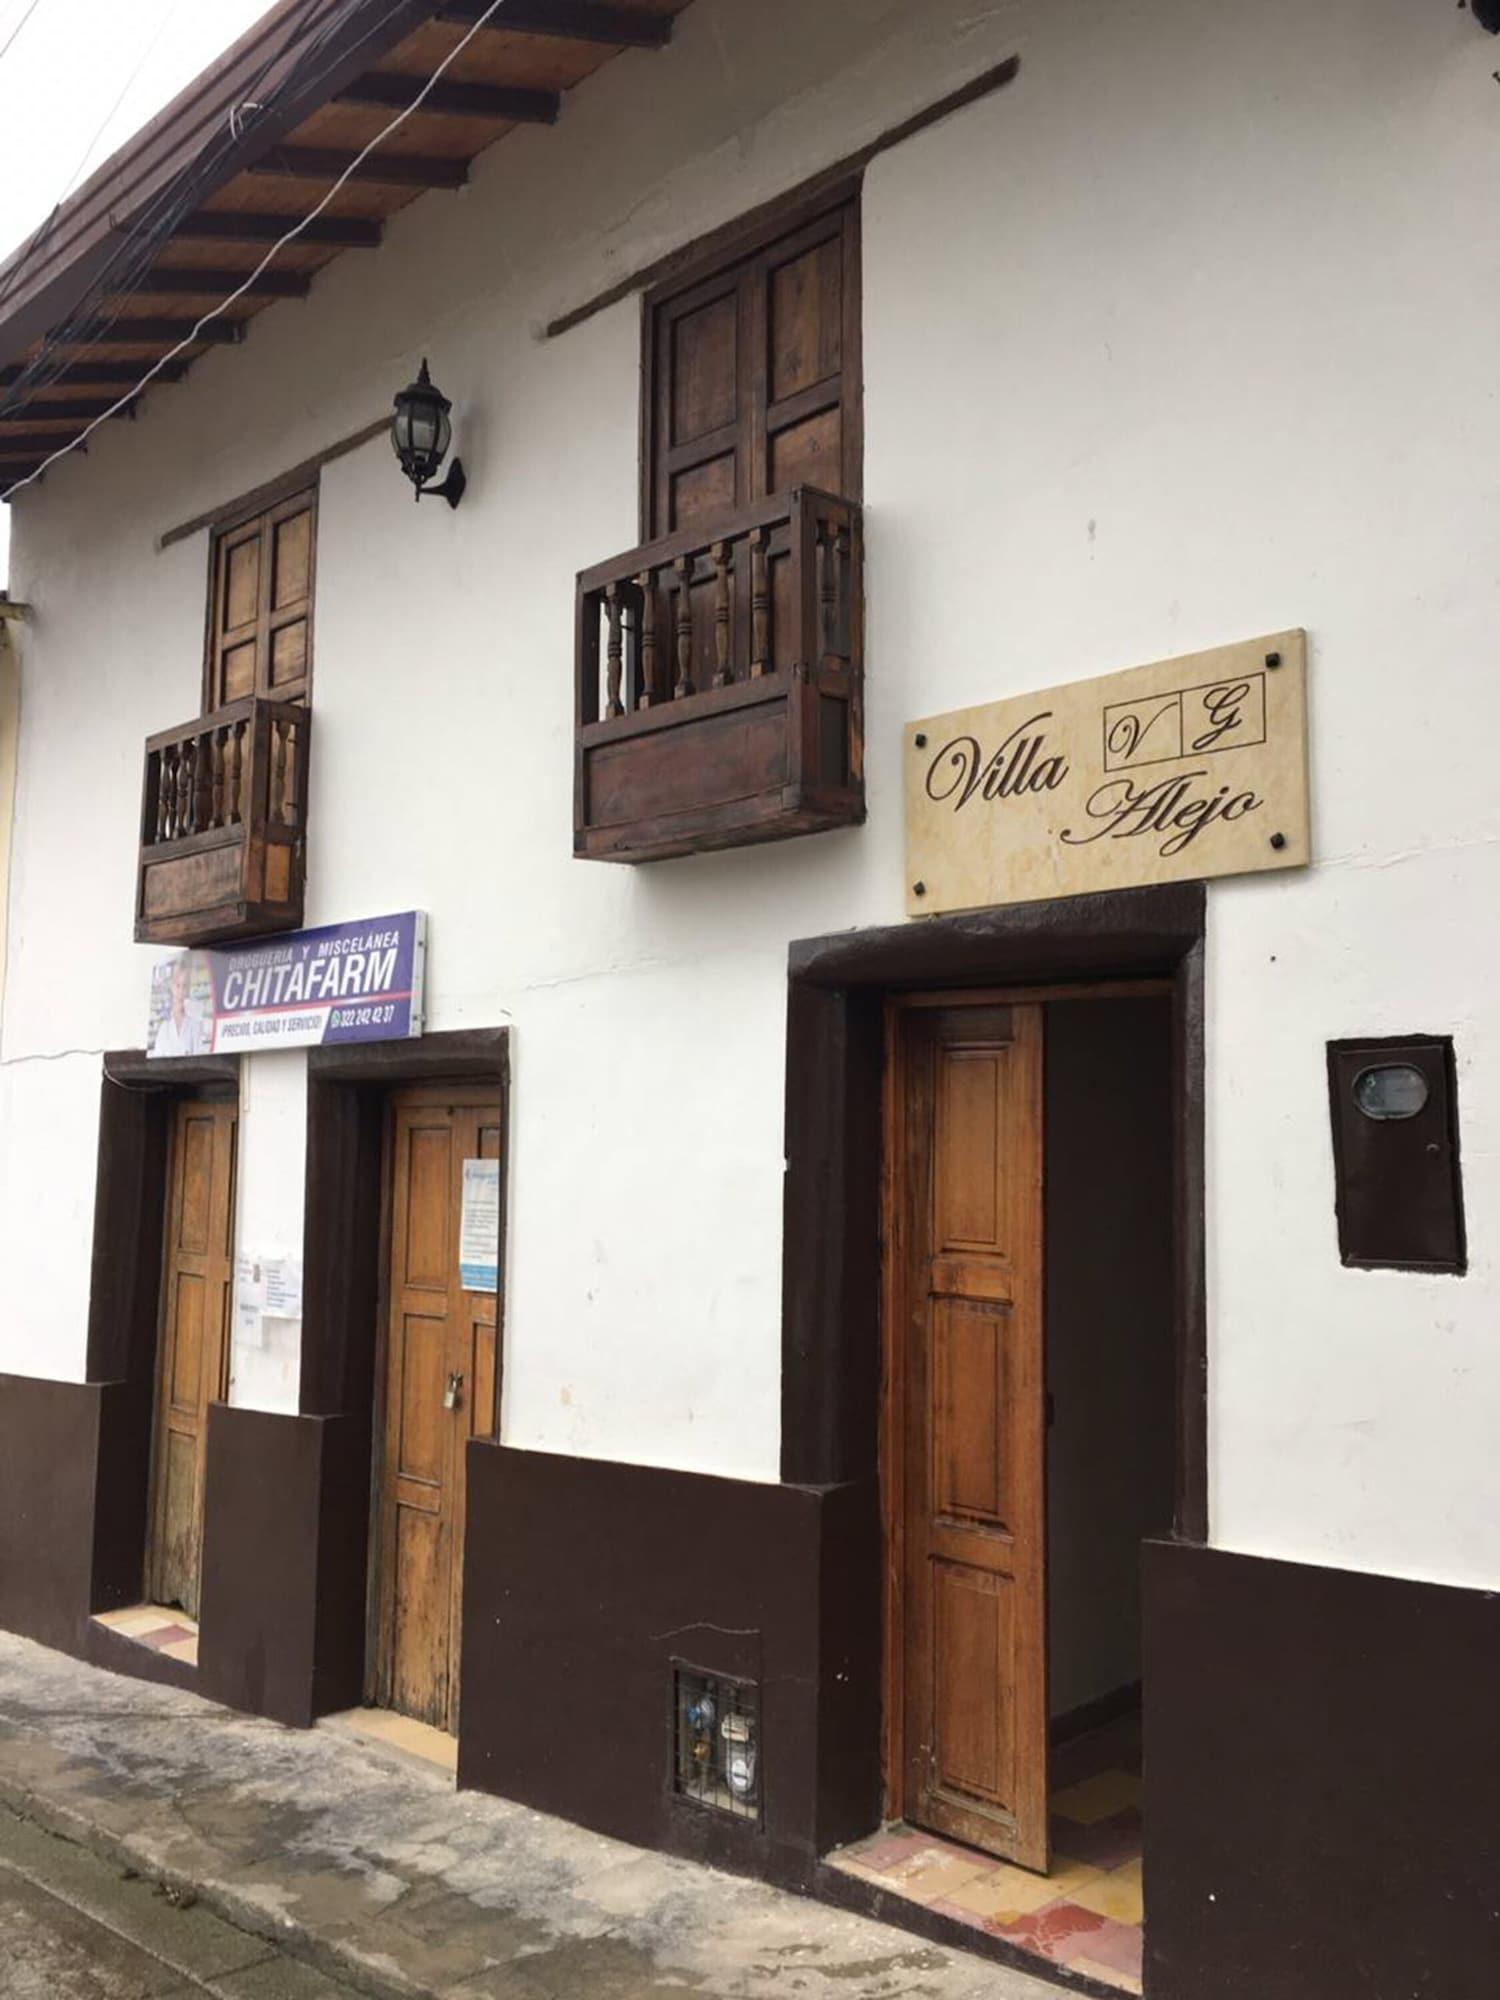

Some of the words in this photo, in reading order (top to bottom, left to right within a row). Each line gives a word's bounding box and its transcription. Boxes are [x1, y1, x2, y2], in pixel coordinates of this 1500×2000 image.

[1108, 701, 1178, 760] V
[926, 712, 1069, 812] Villa
[1060, 771, 1264, 857] Alejo
[302, 946, 310, 960] Y
[318, 931, 399, 957] MISCELÁNEA
[223, 948, 398, 1009] CHITAFARM
